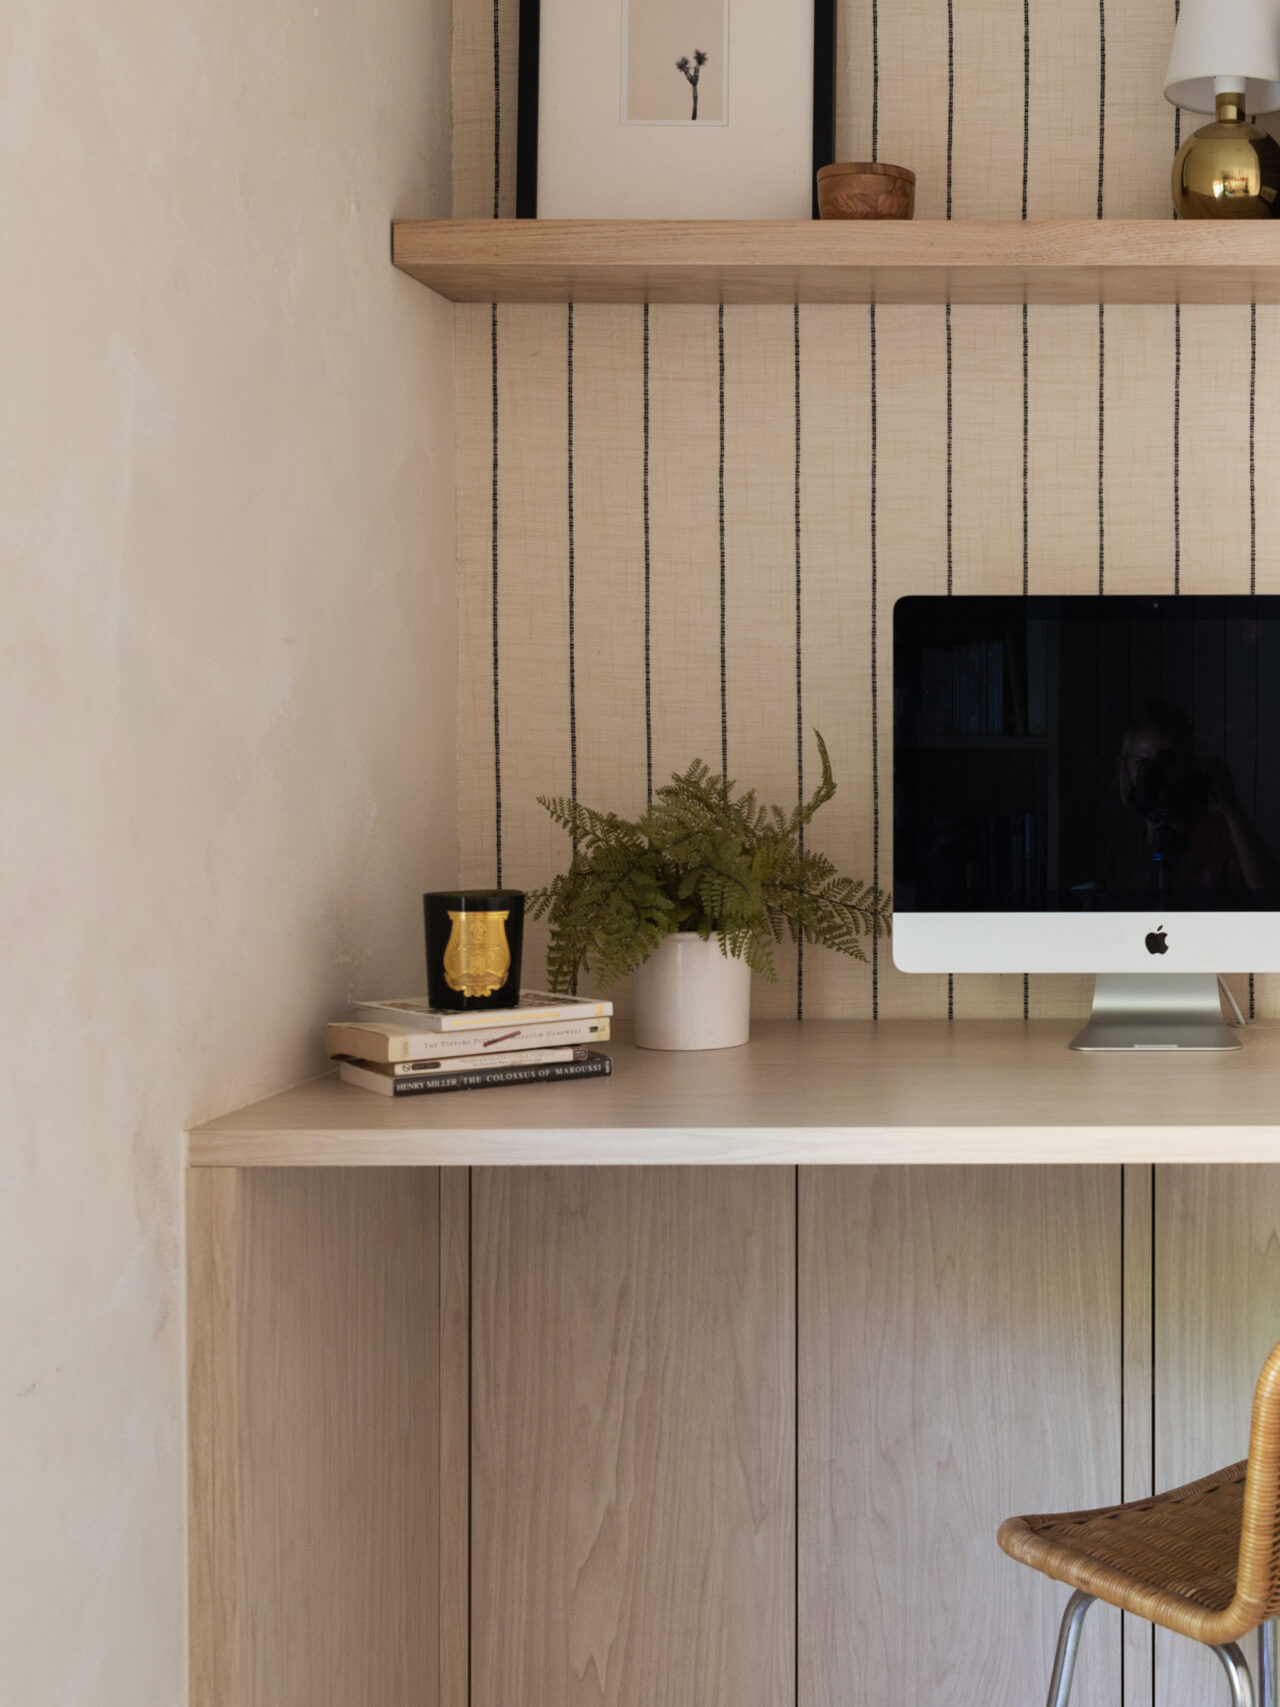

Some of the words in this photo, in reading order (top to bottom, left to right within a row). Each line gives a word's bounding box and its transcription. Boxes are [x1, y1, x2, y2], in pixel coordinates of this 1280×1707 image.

[396, 1081, 425, 1091] HENRY
[426, 1078, 458, 1089] MILLER
[463, 1075, 482, 1085] THE
[486, 1069, 536, 1082] COLOSSUS
[538, 1068, 551, 1078] OF
[555, 1064, 602, 1076] MAROUSSI
